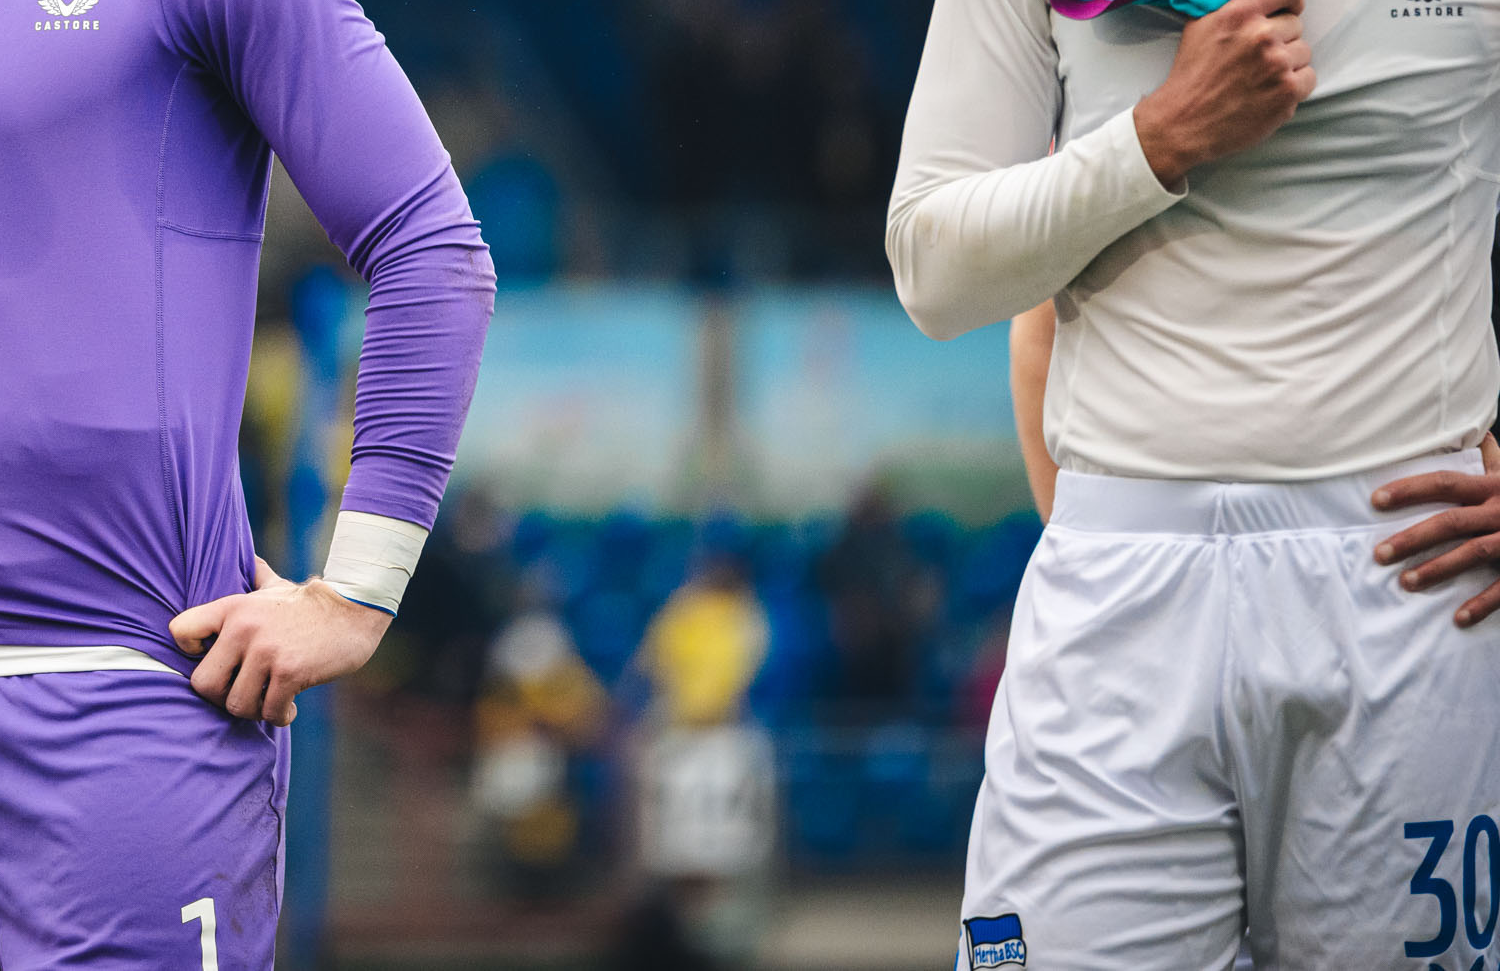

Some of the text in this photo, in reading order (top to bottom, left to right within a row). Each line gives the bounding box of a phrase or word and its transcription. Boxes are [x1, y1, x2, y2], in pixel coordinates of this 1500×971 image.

[1390, 6, 1464, 18] CASTORE
[34, 20, 100, 31] CASTORE
[1403, 814, 1500, 958] 30
